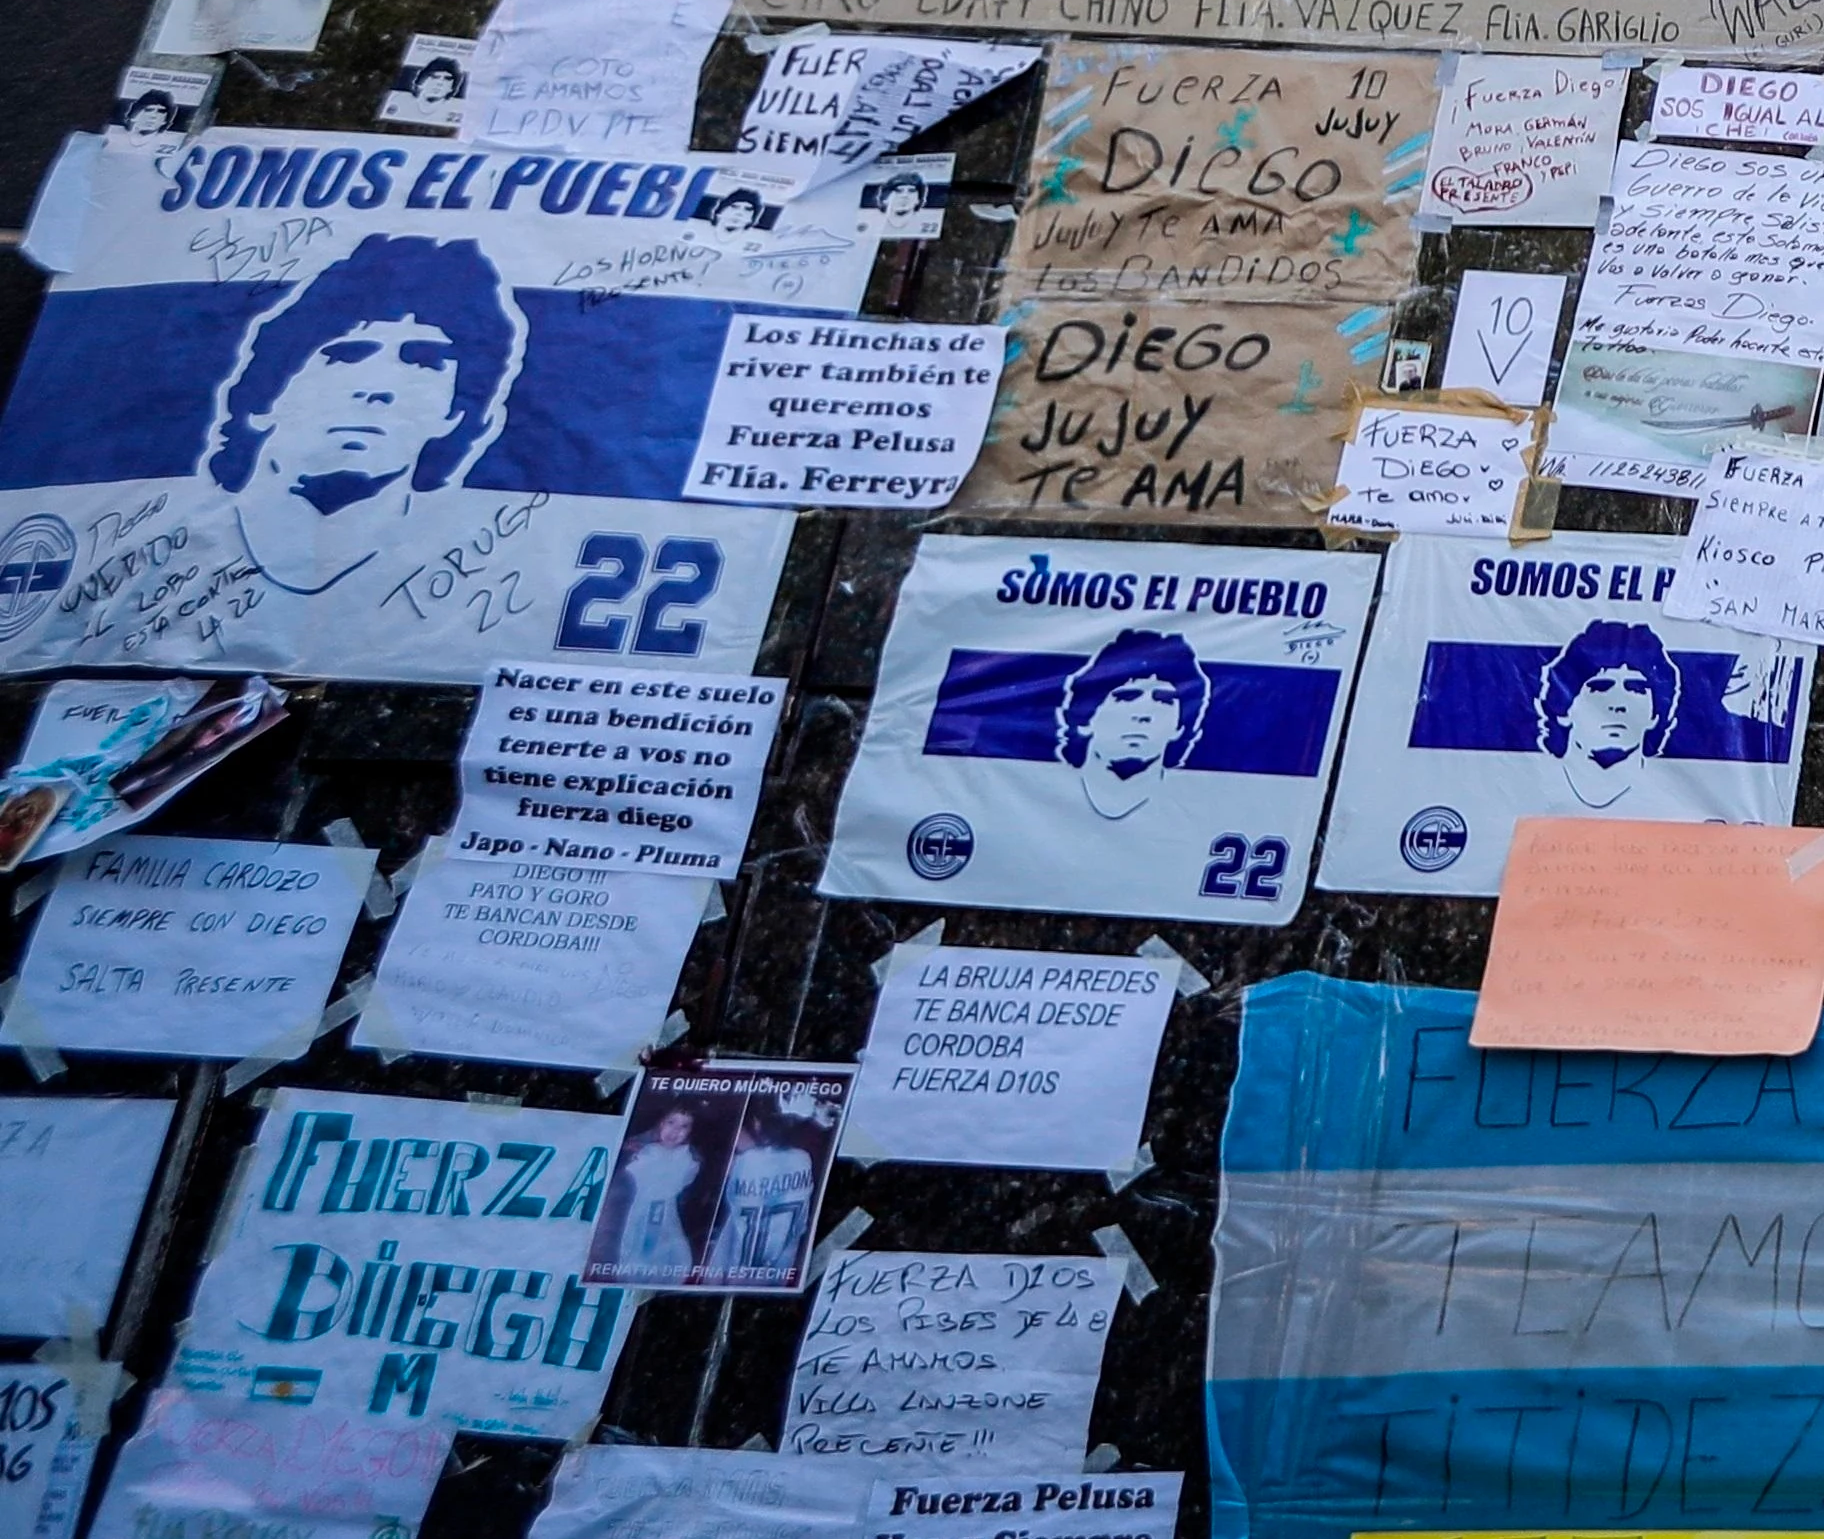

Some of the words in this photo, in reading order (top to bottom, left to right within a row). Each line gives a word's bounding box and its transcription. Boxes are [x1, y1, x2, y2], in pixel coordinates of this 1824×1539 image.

[744, 322, 800, 347] Los
[808, 326, 941, 354] Hinchas
[951, 329, 986, 354] de
[767, 395, 933, 423] queremos
[725, 425, 843, 451] Fuerza
[851, 430, 956, 454] Pelusa
[997, 567, 1137, 612] SOMOS
[1143, 574, 1178, 612] EL
[1187, 576, 1329, 620] PUEBLO
[1199, 831, 1290, 901] 22
[918, 964, 950, 988] LA
[954, 965, 1035, 993] BRUJA
[1040, 967, 1159, 995] PAREDES
[912, 998, 943, 1021] TE
[947, 1000, 1035, 1025] BANCA
[1040, 1002, 1125, 1027] DESDE
[903, 1032, 1025, 1059] CORDOBA
[893, 1066, 992, 1094] FUERZA
[995, 1068, 1060, 1095] D10S
